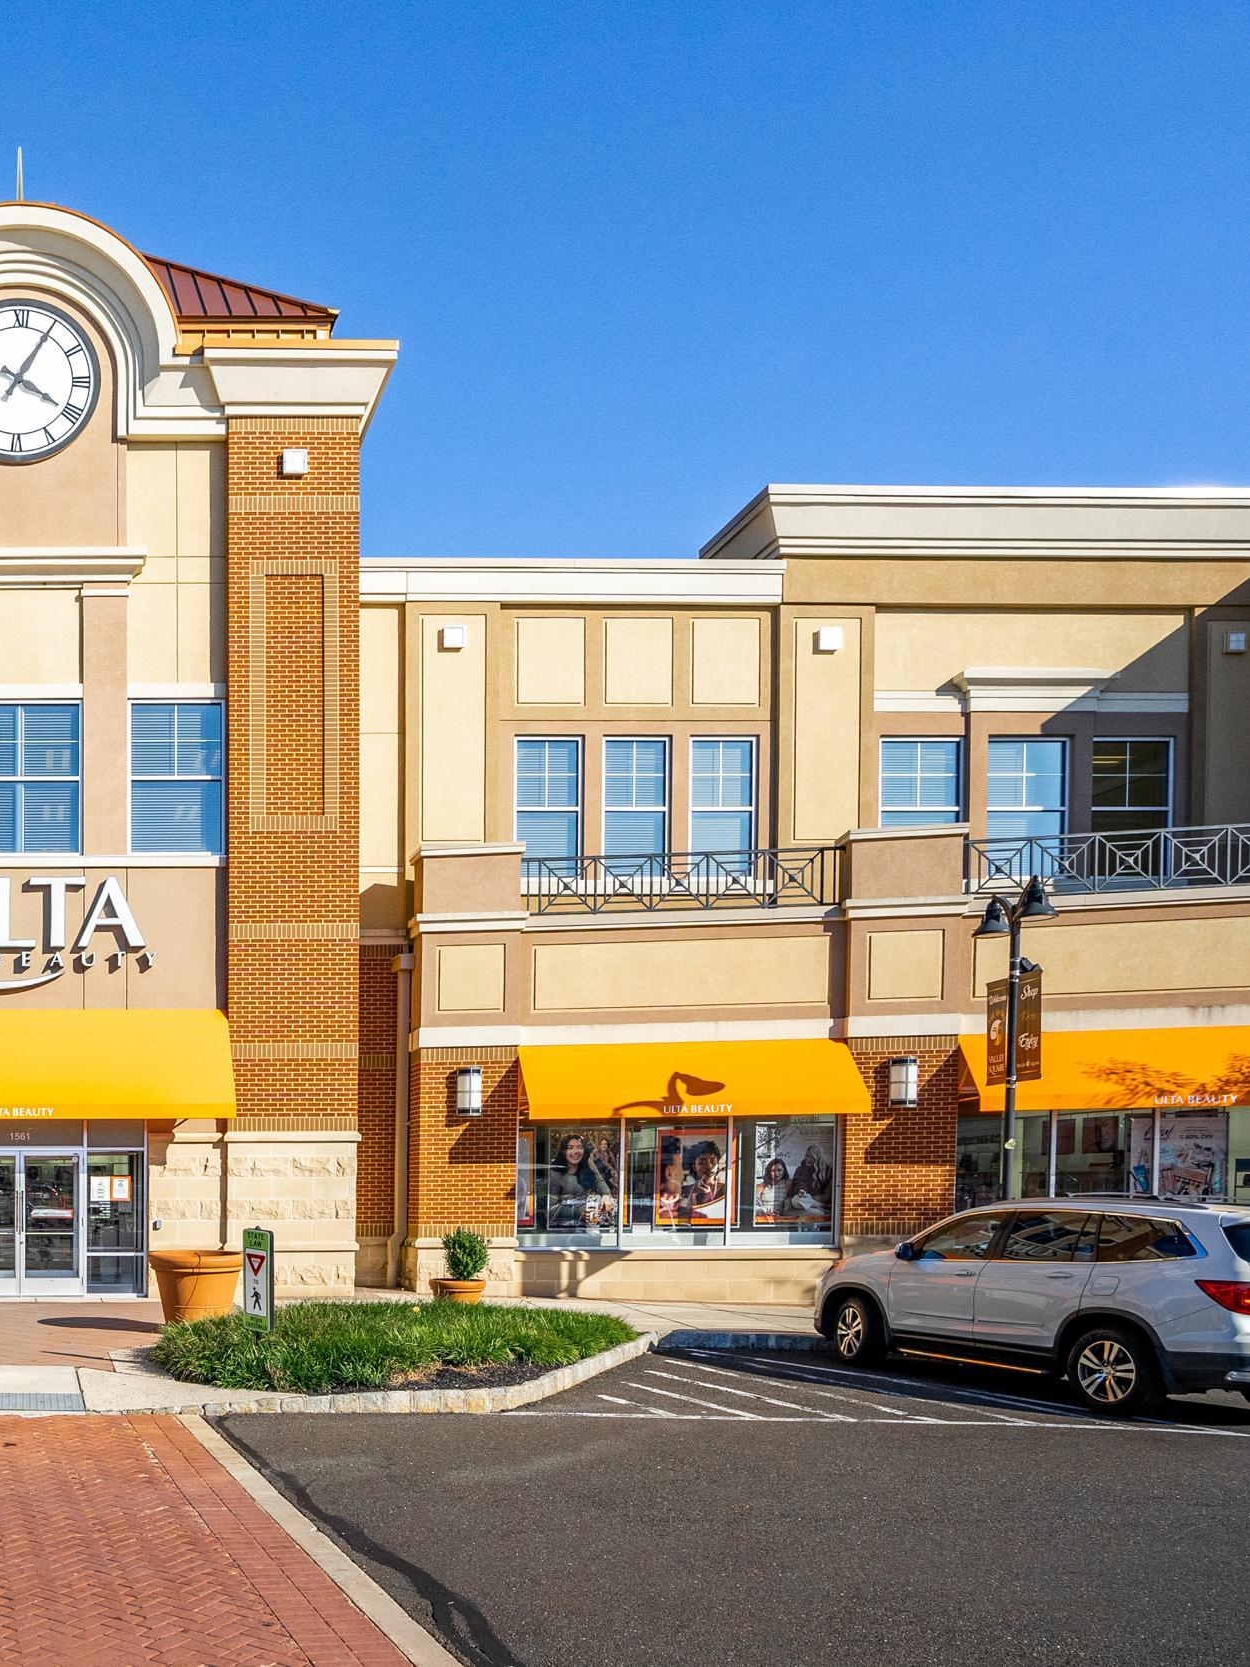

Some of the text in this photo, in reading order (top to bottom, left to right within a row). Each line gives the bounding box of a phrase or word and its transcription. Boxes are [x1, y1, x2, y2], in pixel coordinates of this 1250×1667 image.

[1020, 984, 1039, 1000] Shop
[1018, 1032, 1039, 1051] Enjoy
[1154, 1094, 1238, 1105] ULTA BEAUTY
[12, 1107, 54, 1117] BEAUTY
[663, 1104, 733, 1114] ULTA BEAUTY
[9, 1132, 31, 1141] 1561
[247, 1231, 265, 1241] STATE
[249, 1240, 262, 1248] LAW
